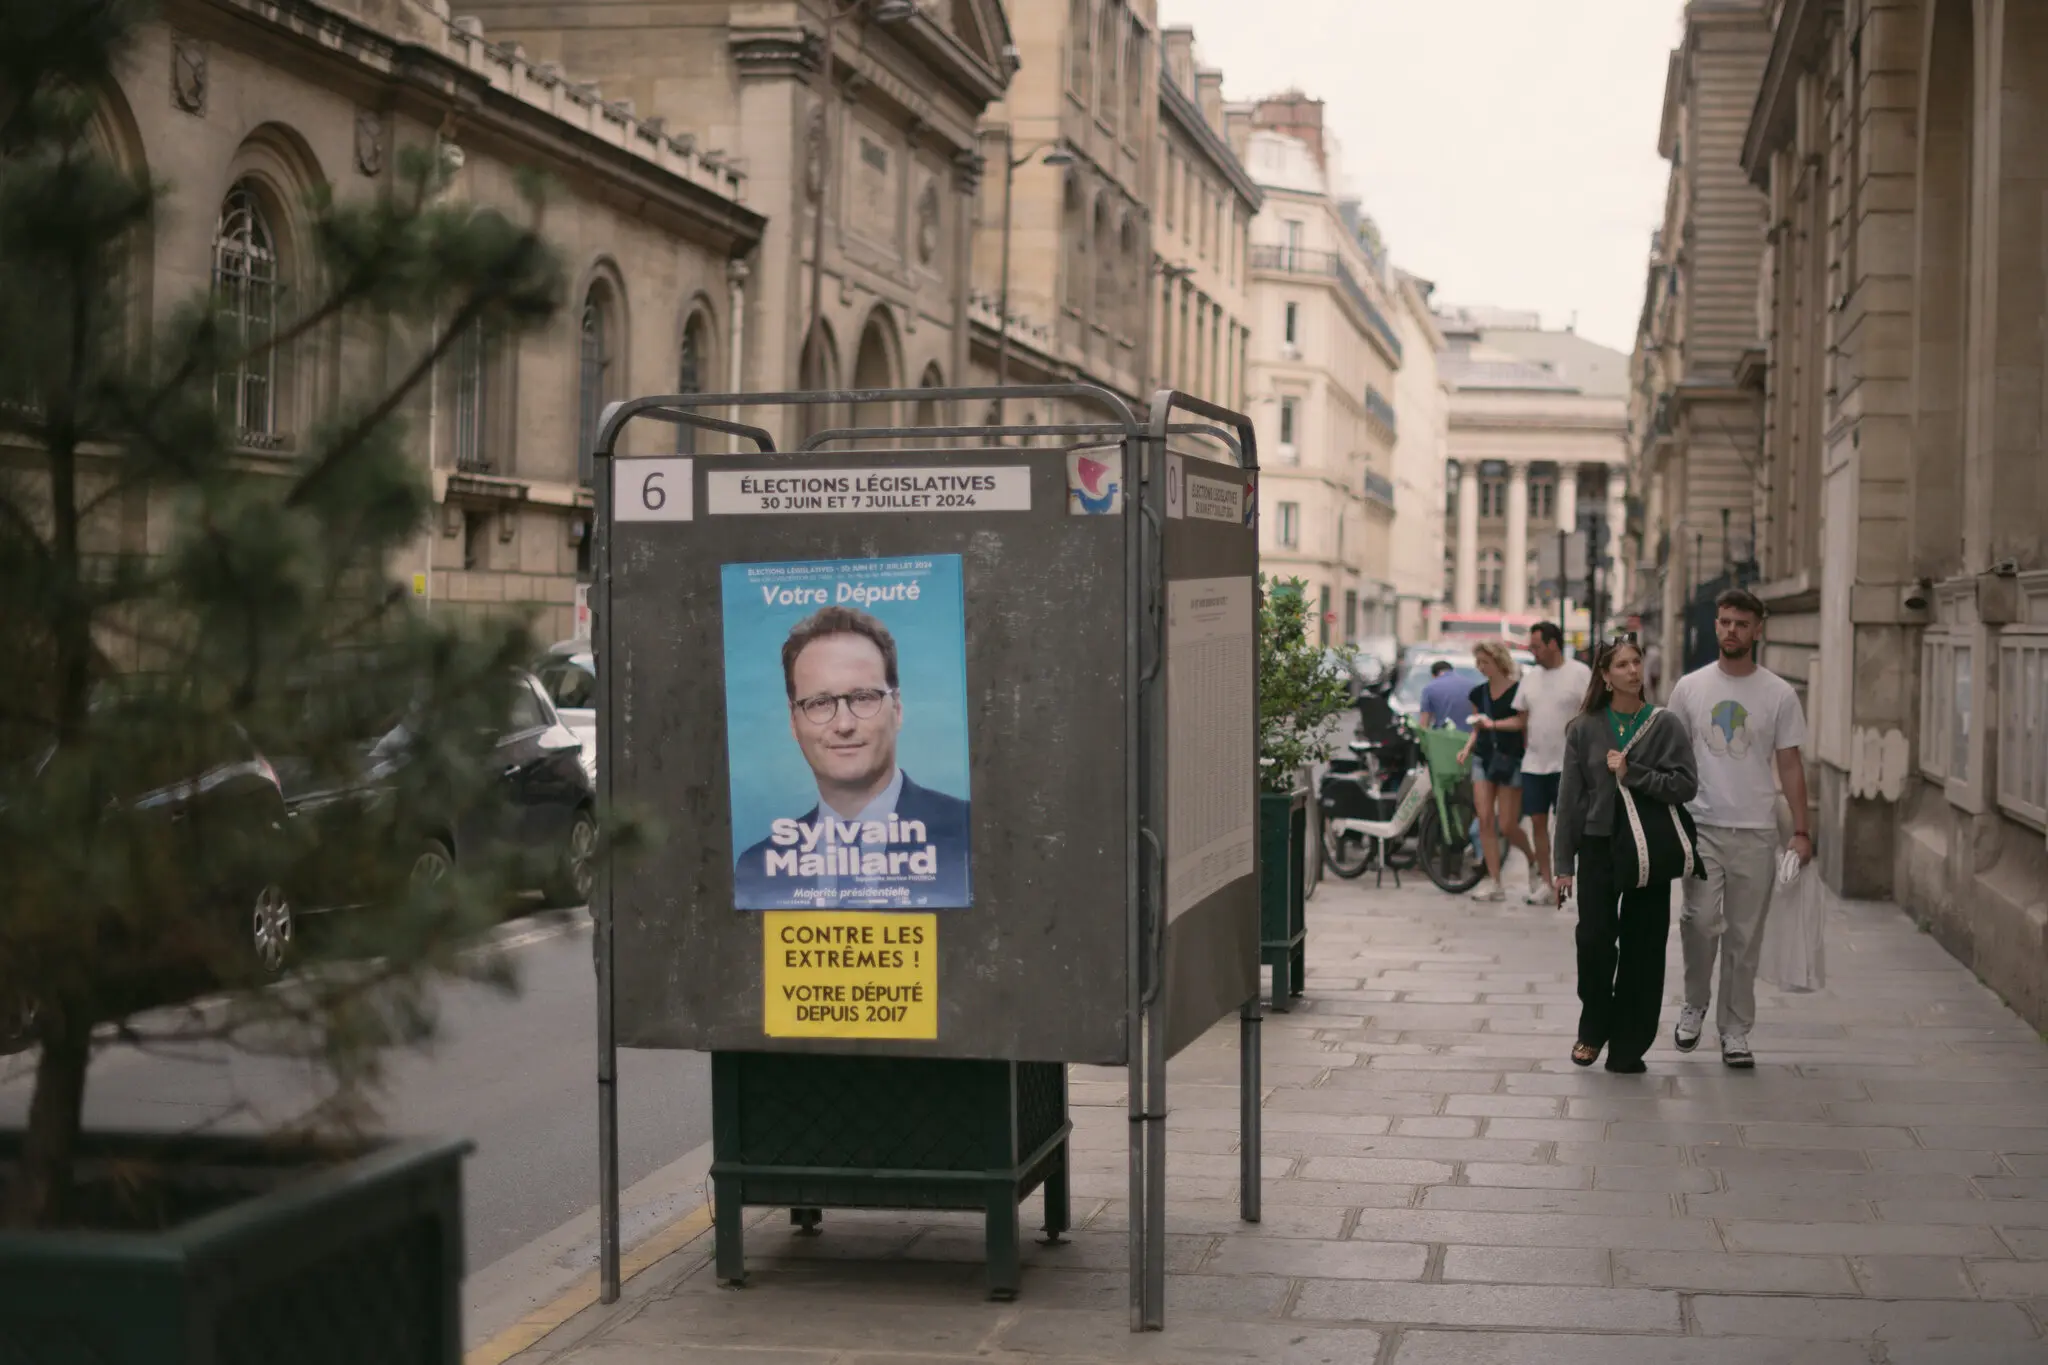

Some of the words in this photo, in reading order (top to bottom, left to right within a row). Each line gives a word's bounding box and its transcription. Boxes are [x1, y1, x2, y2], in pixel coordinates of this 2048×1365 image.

[642, 472, 666, 511] 6
[741, 475, 850, 494] ÉLECTIONS
[855, 474, 996, 493] LÉGISLATIVES
[761, 497, 780, 509] 30
[785, 496, 822, 509] JUIN
[827, 496, 846, 508] ET
[852, 496, 861, 508] 7
[866, 495, 931, 508] JUILLET
[936, 494, 976, 507] 2024
[762, 585, 828, 606] Votre
[836, 580, 920, 608] Député
[771, 813, 927, 852] Sylvain
[765, 845, 937, 877] Maillard
[794, 887, 837, 899] Majorité
[840, 886, 910, 899] présidentielle
[780, 926, 874, 945] CONTRE
[883, 926, 924, 945] LES
[785, 945, 904, 968] EXTRÊMES
[914, 951, 920, 968] !
[782, 985, 846, 1002] VOTRE
[852, 981, 923, 1002] DÉPUTÉ
[796, 1005, 859, 1022] DEPUIS
[866, 1006, 908, 1022] 2017
